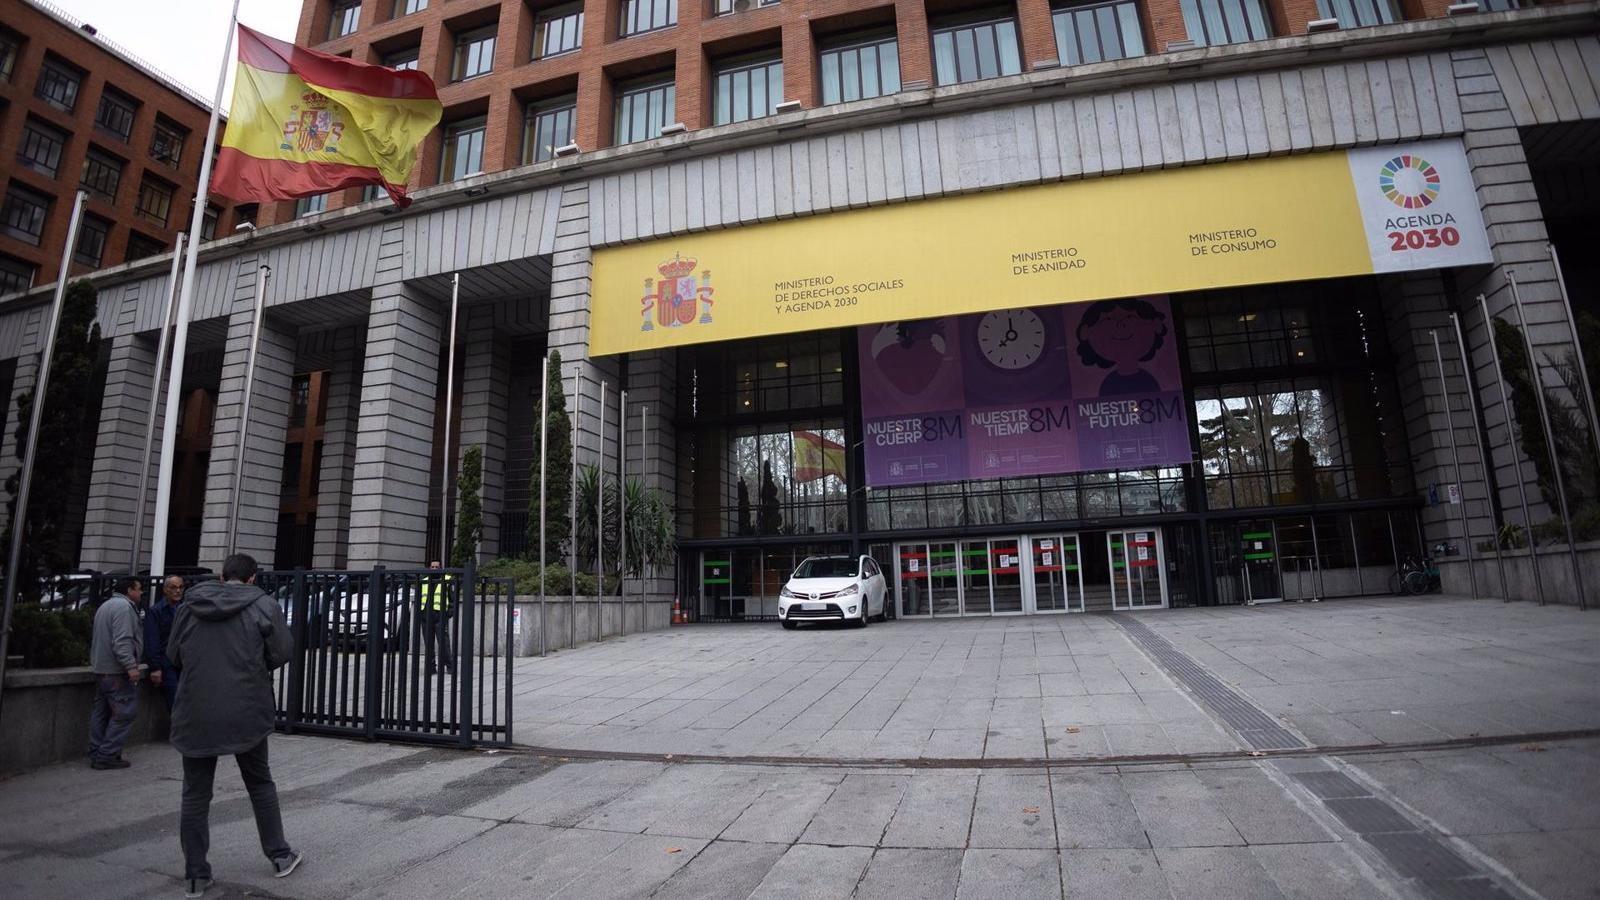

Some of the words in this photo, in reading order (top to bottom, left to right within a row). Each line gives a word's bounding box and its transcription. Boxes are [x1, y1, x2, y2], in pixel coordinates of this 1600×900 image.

[1385, 213, 1456, 230] AGENDA
[1189, 228, 1257, 243] MINISTERIO
[1388, 226, 1460, 251] 2030
[1012, 247, 1078, 263] MINISTERIO
[1191, 245, 1208, 257] DE
[1211, 239, 1277, 254] CONSUMO
[1013, 265, 1029, 276] DE
[1032, 259, 1086, 273] SANIDAD
[775, 275, 834, 291] MINISTERIO
[775, 292, 789, 303] DE
[792, 285, 850, 301] DERECHOS
[852, 279, 904, 294] SOCIALES
[775, 305, 782, 314] Y
[785, 300, 831, 314] AGENDA
[834, 296, 858, 308] 2030
[1079, 400, 1138, 417] NUESTR
[1139, 396, 1183, 424] 8M
[971, 409, 1028, 426] NUESTR
[1028, 405, 1072, 433] 8M
[1089, 413, 1140, 429] FUTUR
[867, 418, 922, 435] NUESTR
[922, 415, 963, 442] 8M
[984, 422, 1029, 437] TIEMP
[876, 432, 923, 446] CUERP
